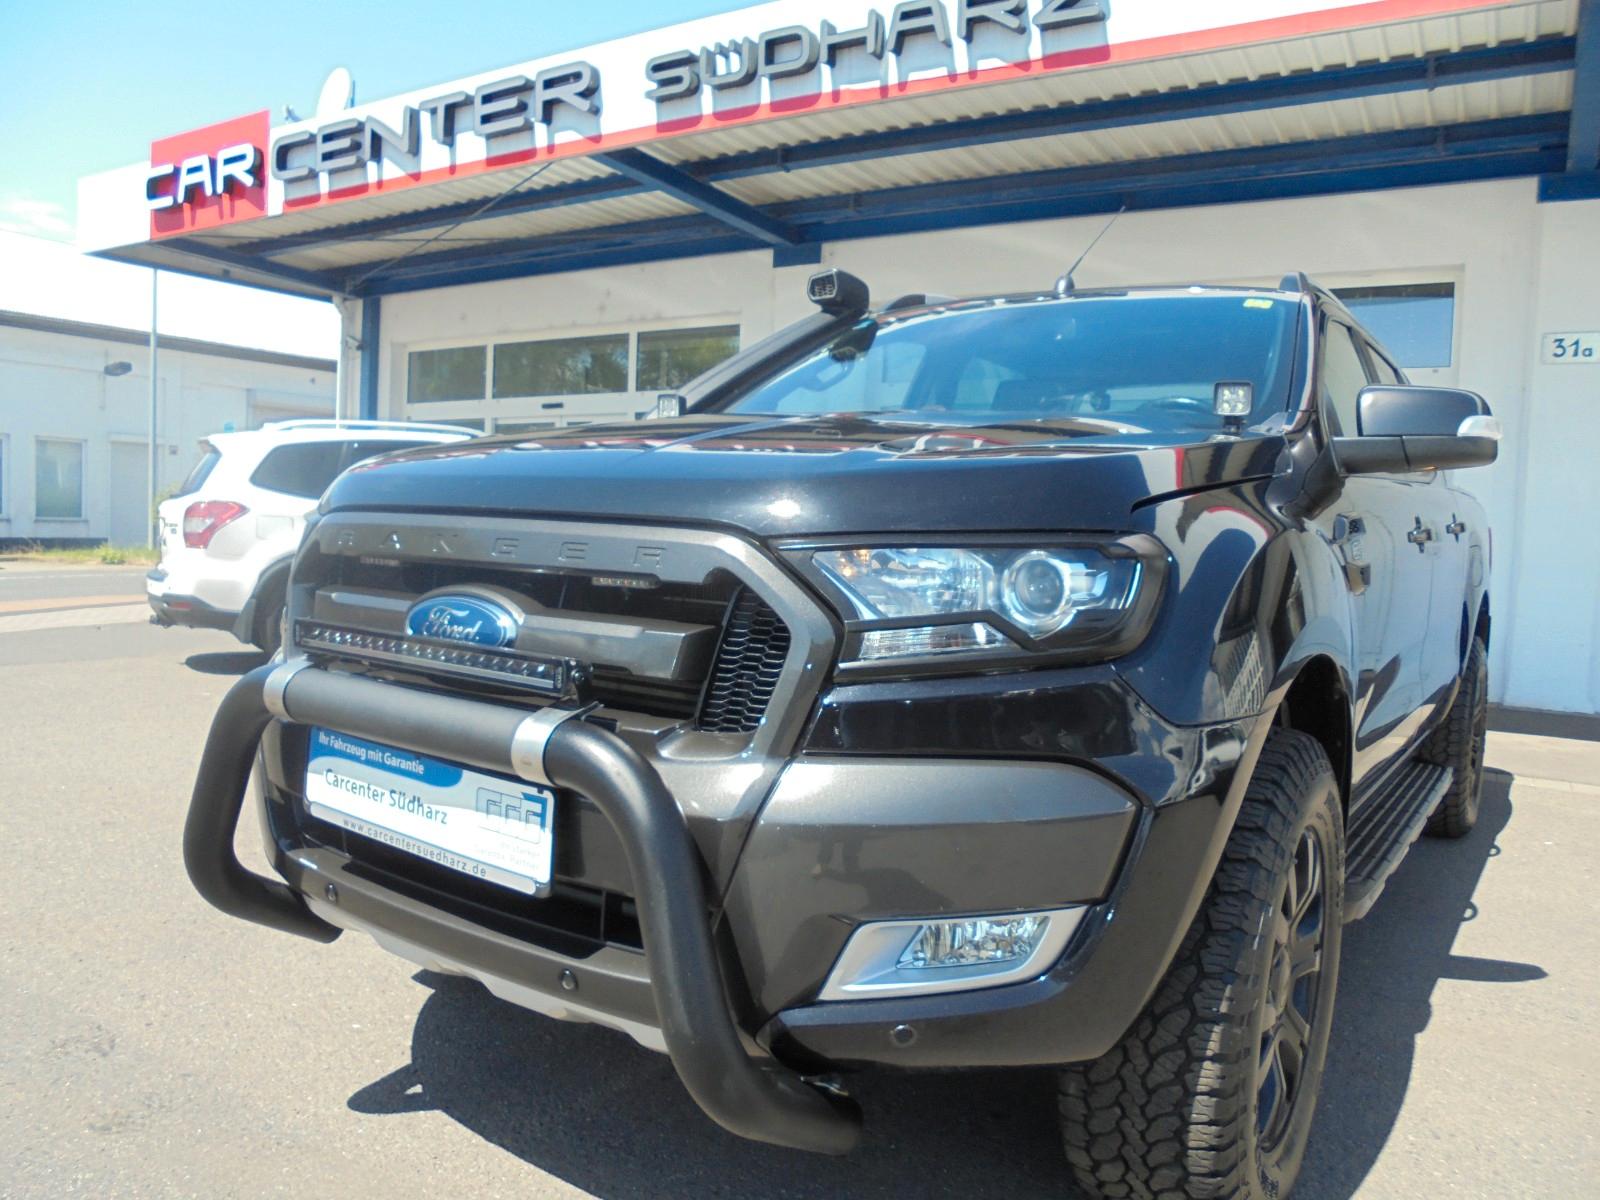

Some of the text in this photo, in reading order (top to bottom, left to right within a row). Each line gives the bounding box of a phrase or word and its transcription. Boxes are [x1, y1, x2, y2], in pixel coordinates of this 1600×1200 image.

[144, 142, 264, 212] CAR
[270, 61, 601, 183] CENTER
[1552, 337, 1593, 358] 31a
[337, 530, 668, 568] RANGER
[423, 605, 483, 641] Ford
[318, 731, 425, 775] Ihr Fahrzeug mit Garantie
[325, 767, 448, 825] Carcenter Südharz
[342, 818, 488, 878] www.carcentersuedharz.de
